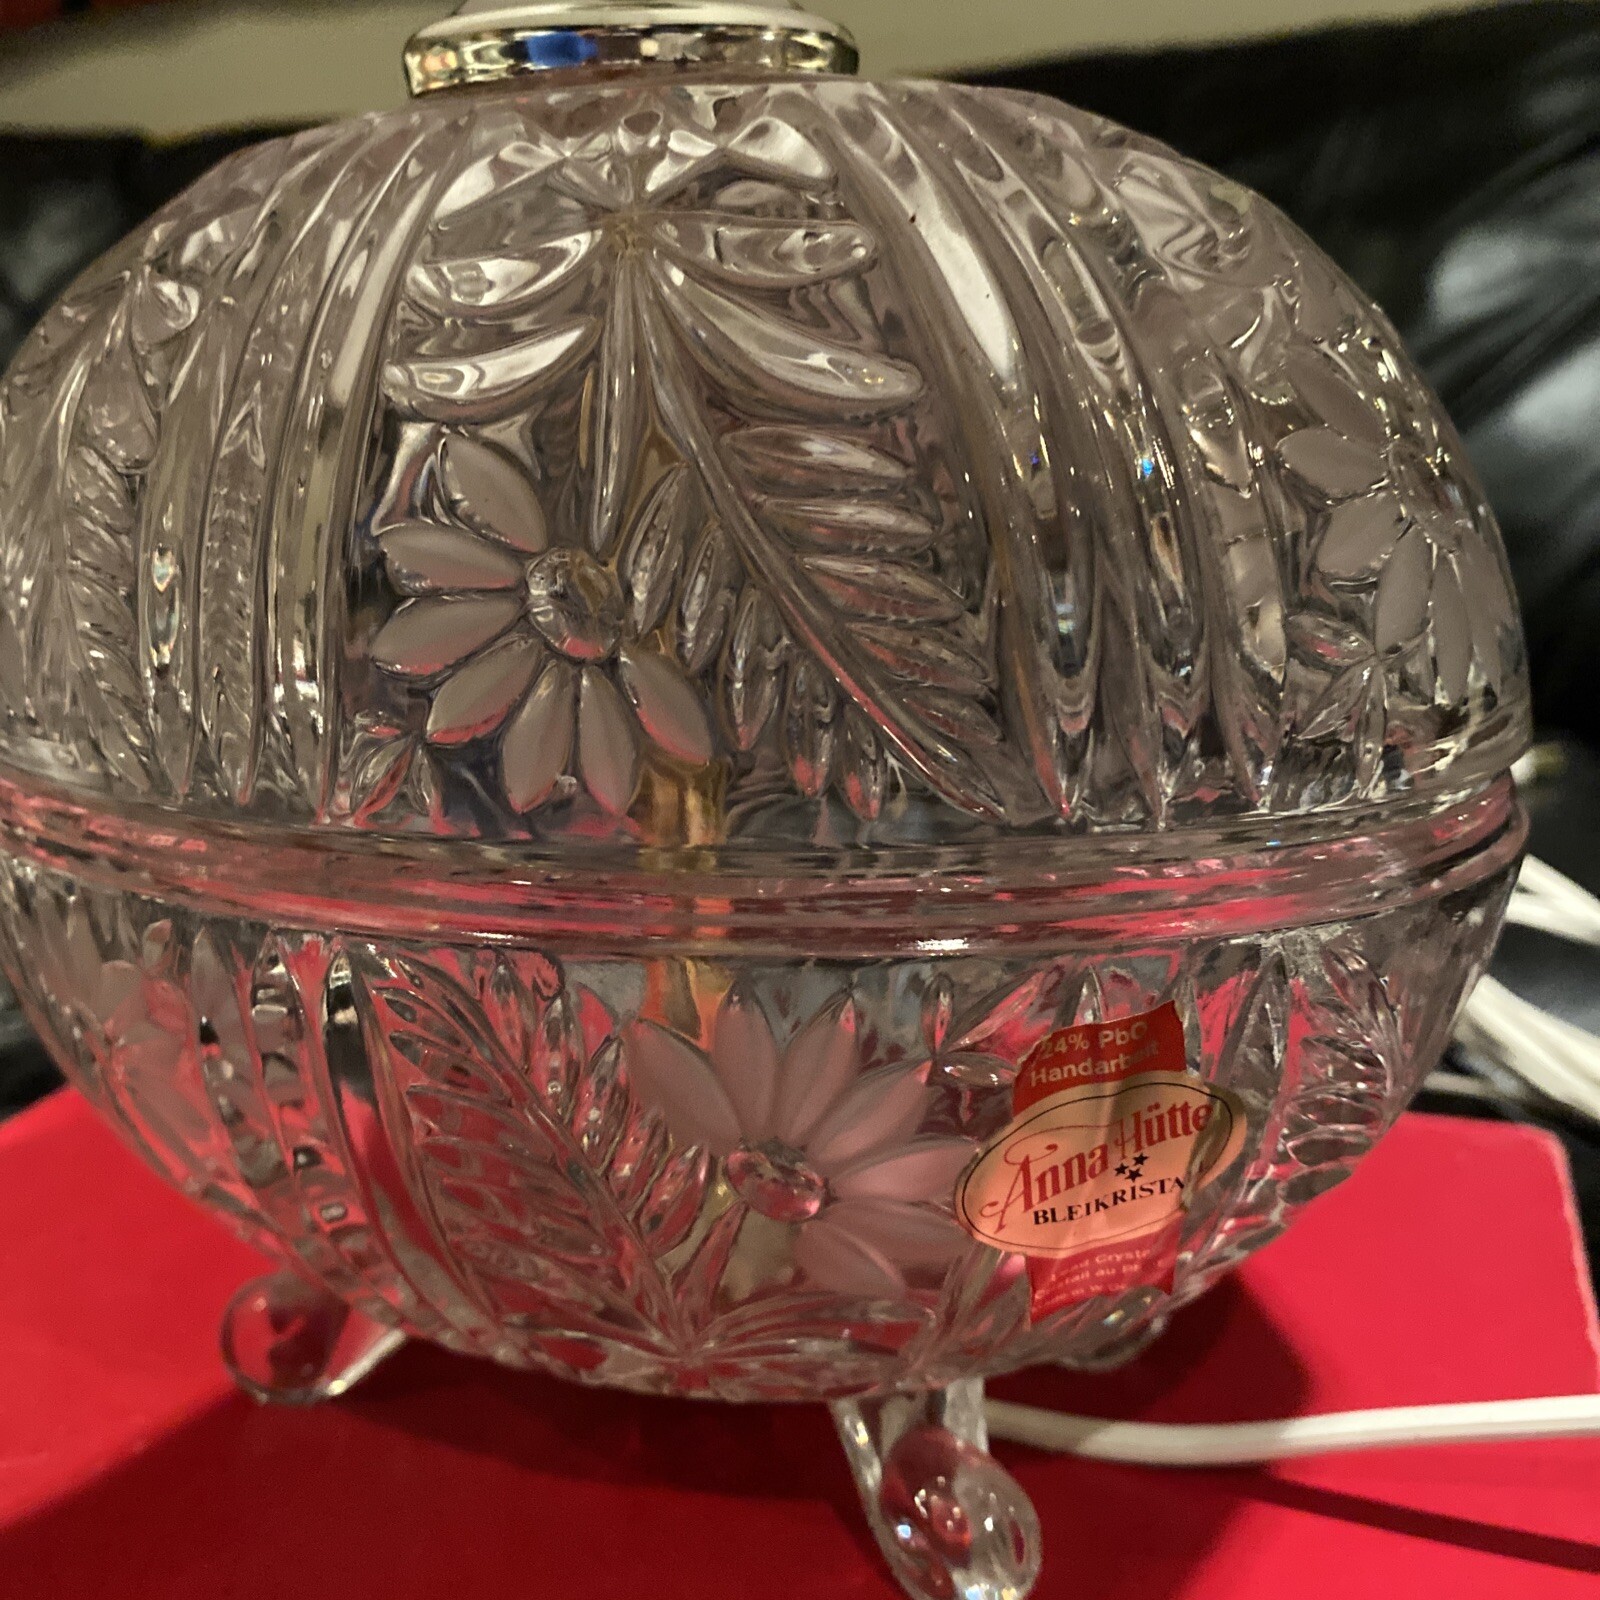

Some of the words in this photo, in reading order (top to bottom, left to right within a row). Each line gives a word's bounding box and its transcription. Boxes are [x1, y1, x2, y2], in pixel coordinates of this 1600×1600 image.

[1030, 1041, 1159, 1088] Handarbit
[1038, 1033, 1090, 1060] 24%
[1098, 1021, 1148, 1049] PbO
[980, 1142, 1109, 1234] Anna
[1114, 1099, 1214, 1160] Hütte
[1032, 1176, 1185, 1226] BLEIKRISTA
